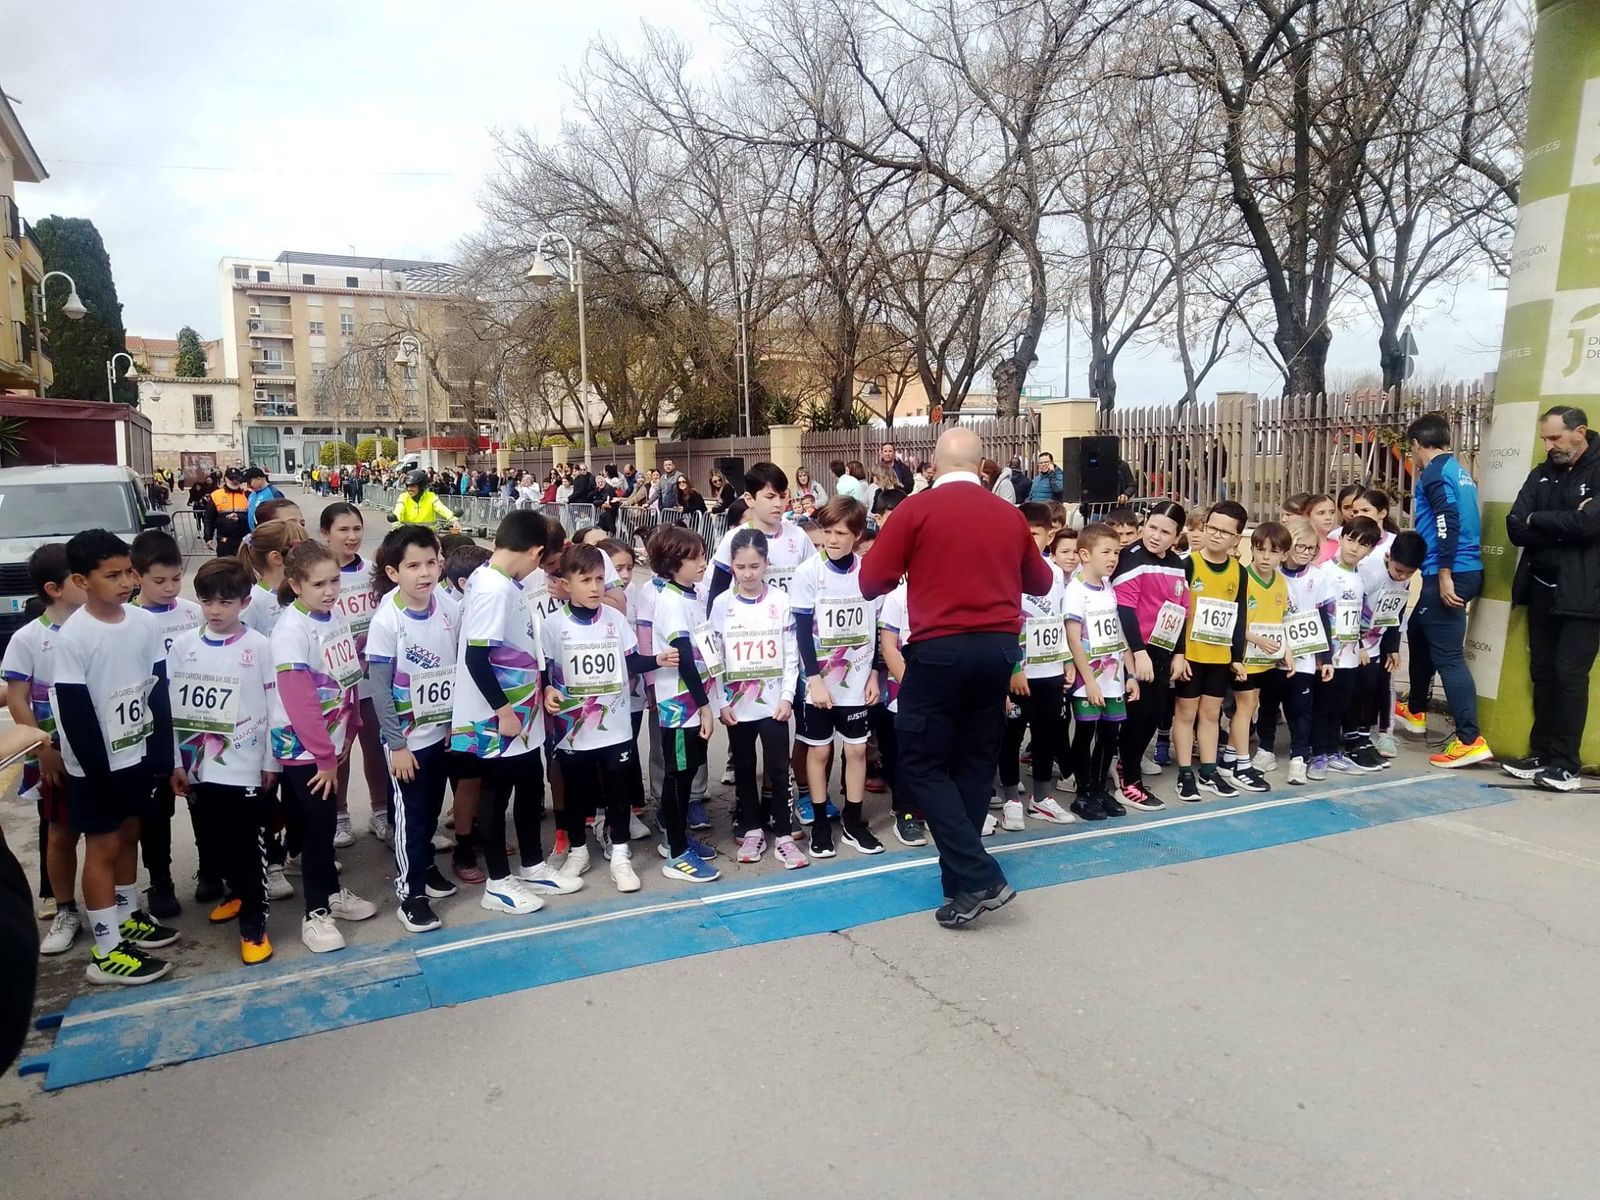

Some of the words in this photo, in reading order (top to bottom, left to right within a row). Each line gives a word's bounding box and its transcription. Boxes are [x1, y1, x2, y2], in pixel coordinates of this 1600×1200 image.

[338, 591, 378, 617] 1678
[1376, 596, 1401, 613] 1648
[825, 607, 863, 628] 1670
[1160, 611, 1181, 633] 1641
[1202, 608, 1233, 628] 1637
[1033, 627, 1063, 647] 1691
[324, 638, 355, 670] 1702
[733, 639, 777, 661] 1713
[570, 652, 615, 676] 1690
[178, 684, 233, 710] 1667
[416, 680, 456, 705] 166
